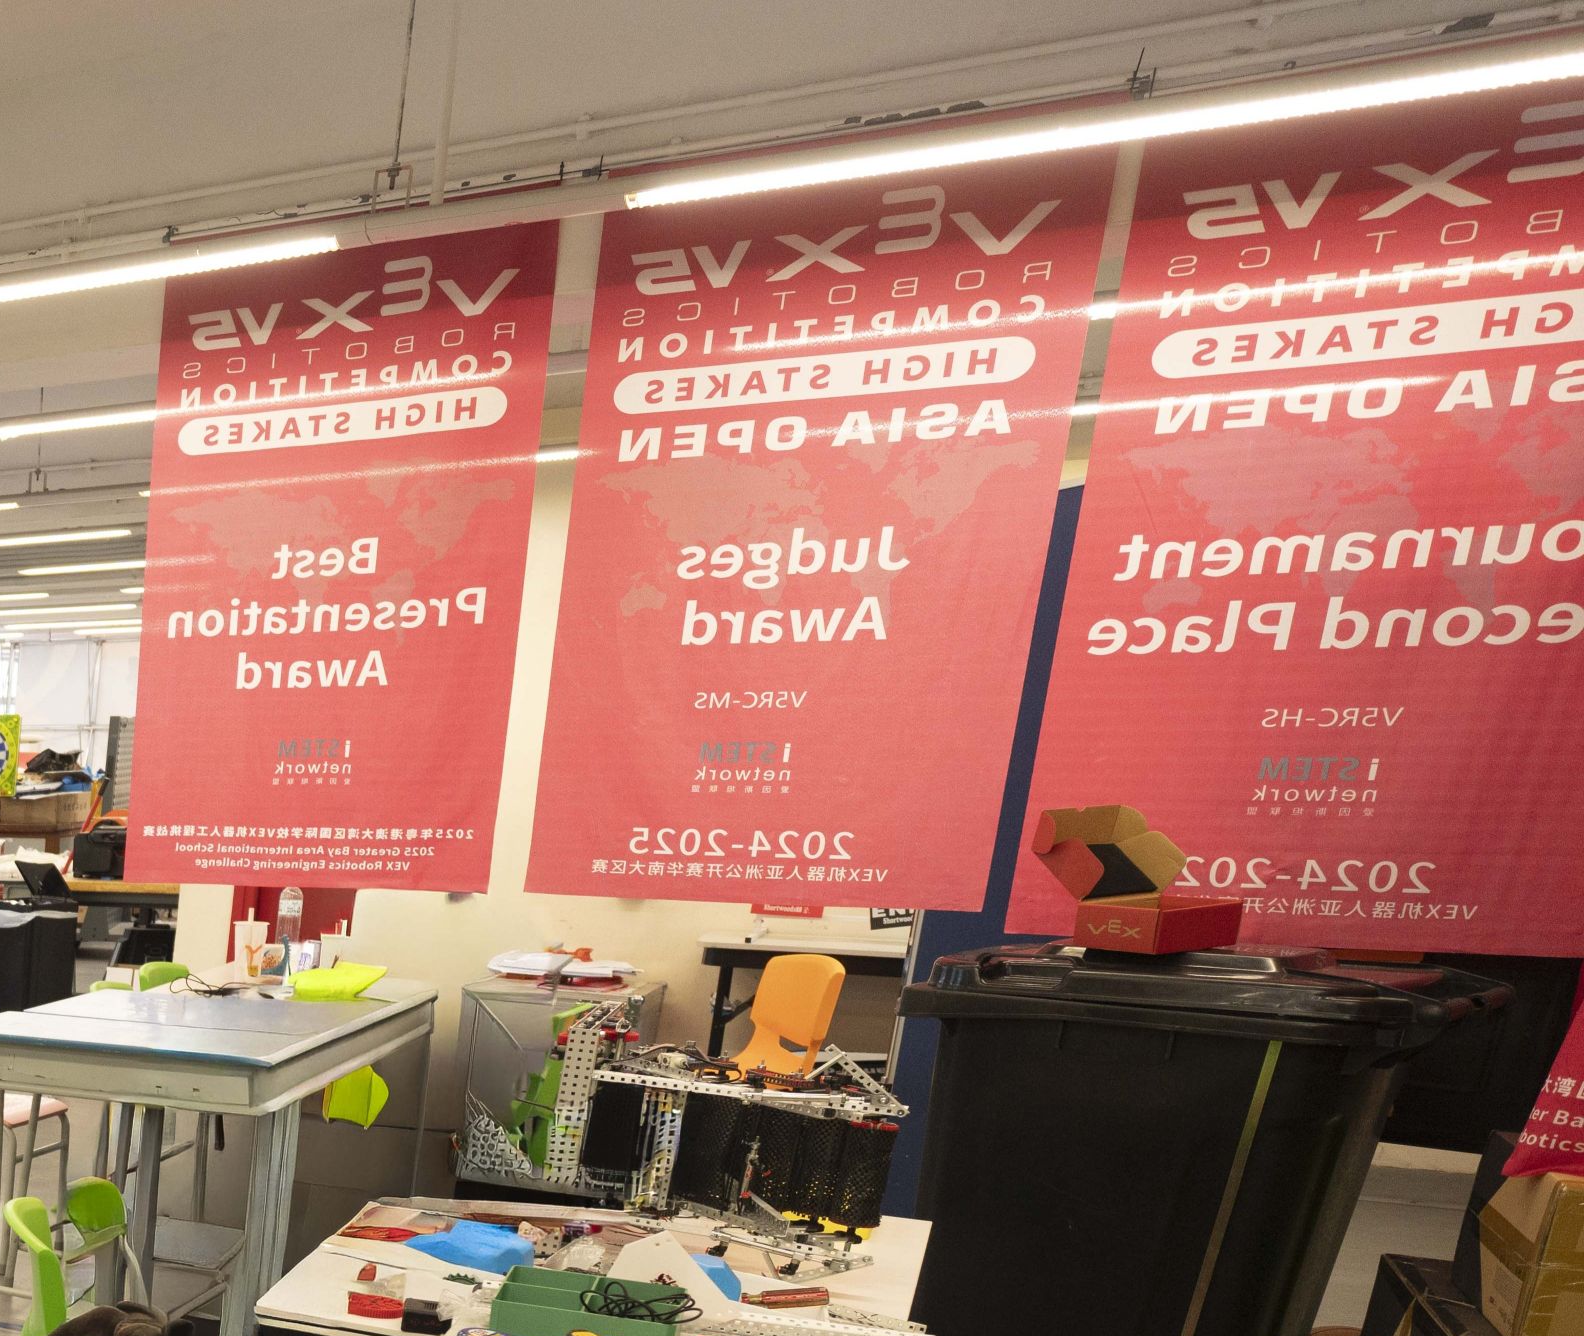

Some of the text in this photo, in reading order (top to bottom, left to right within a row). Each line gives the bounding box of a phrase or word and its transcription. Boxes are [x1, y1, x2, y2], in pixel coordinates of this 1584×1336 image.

[1087, 920, 1142, 938] VEX
[1553, 1109, 1584, 1128] Ba
[1519, 1128, 1584, 1153] botics
